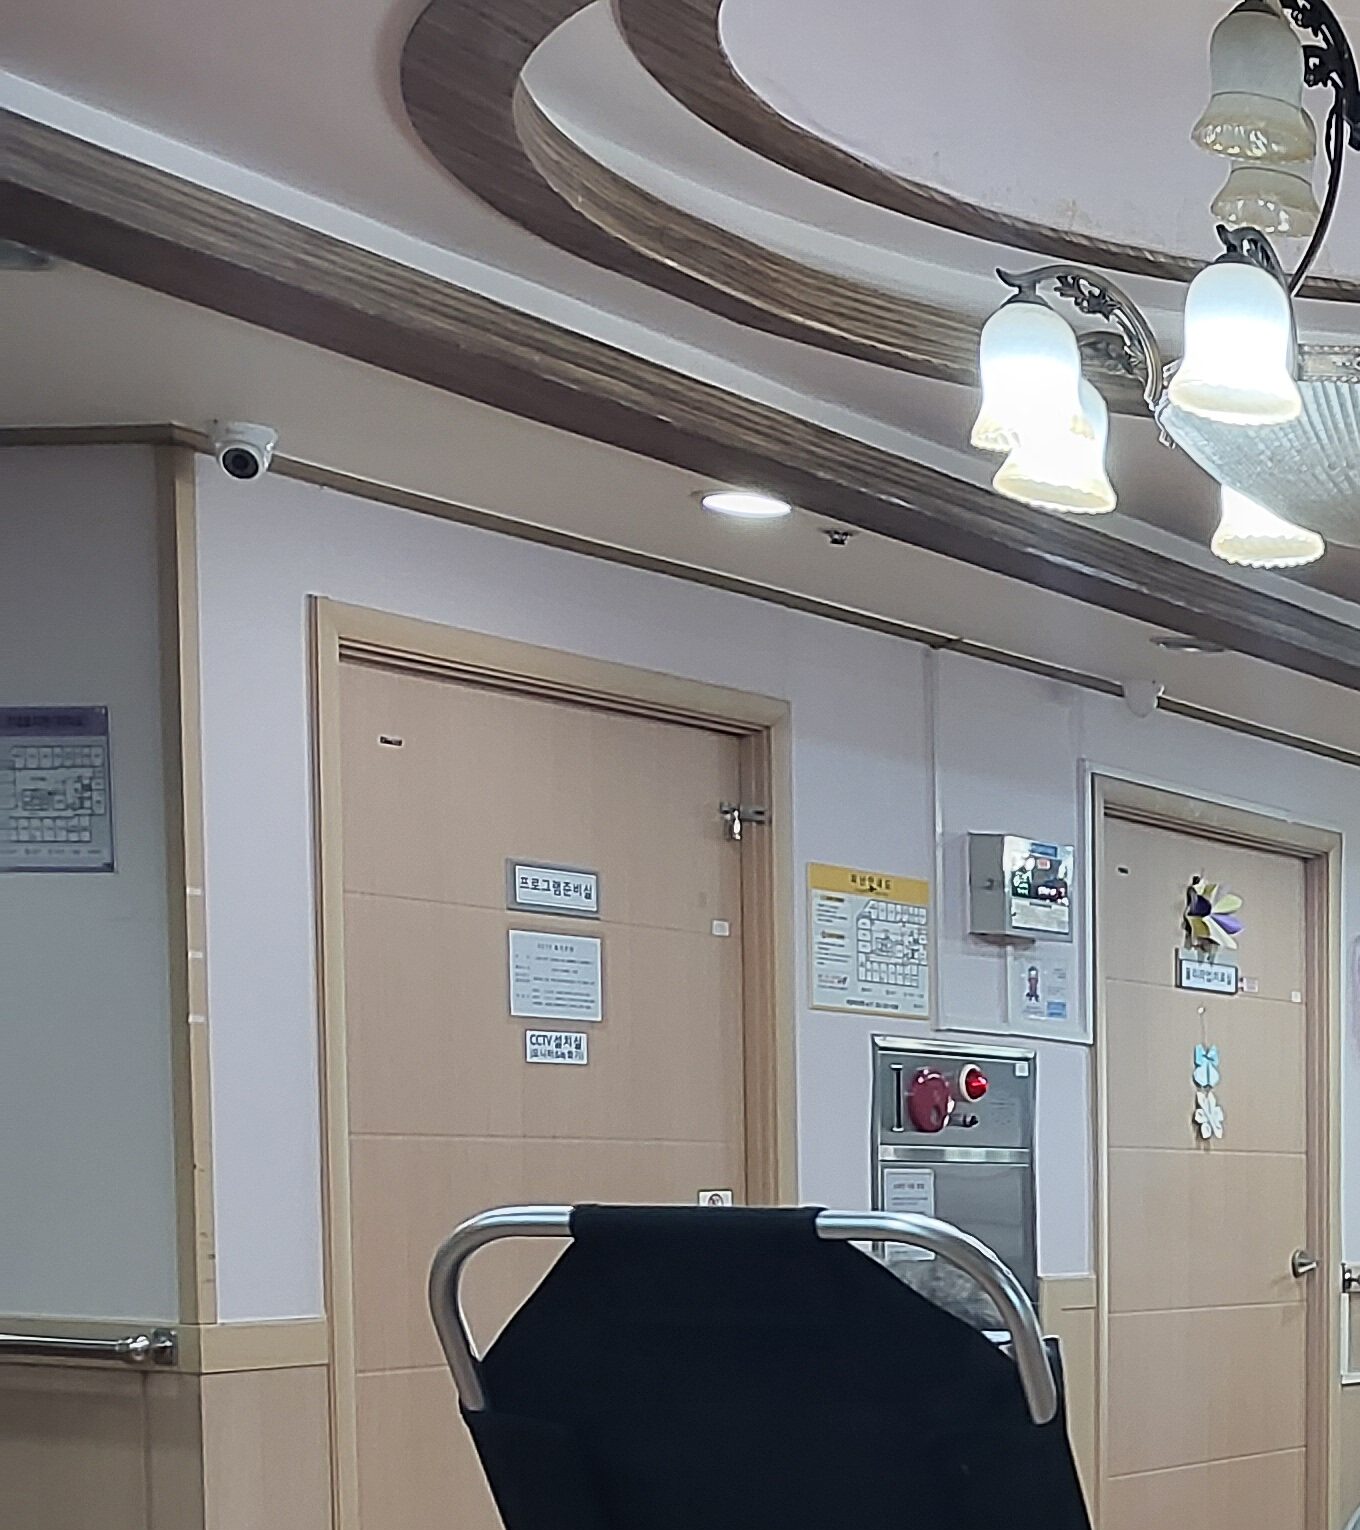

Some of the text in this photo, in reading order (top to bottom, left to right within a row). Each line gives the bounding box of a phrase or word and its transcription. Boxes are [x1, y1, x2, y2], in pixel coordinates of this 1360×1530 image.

[519, 876, 593, 901] 프로그램준비실
[530, 1033, 583, 1050] CCTV 설치실
